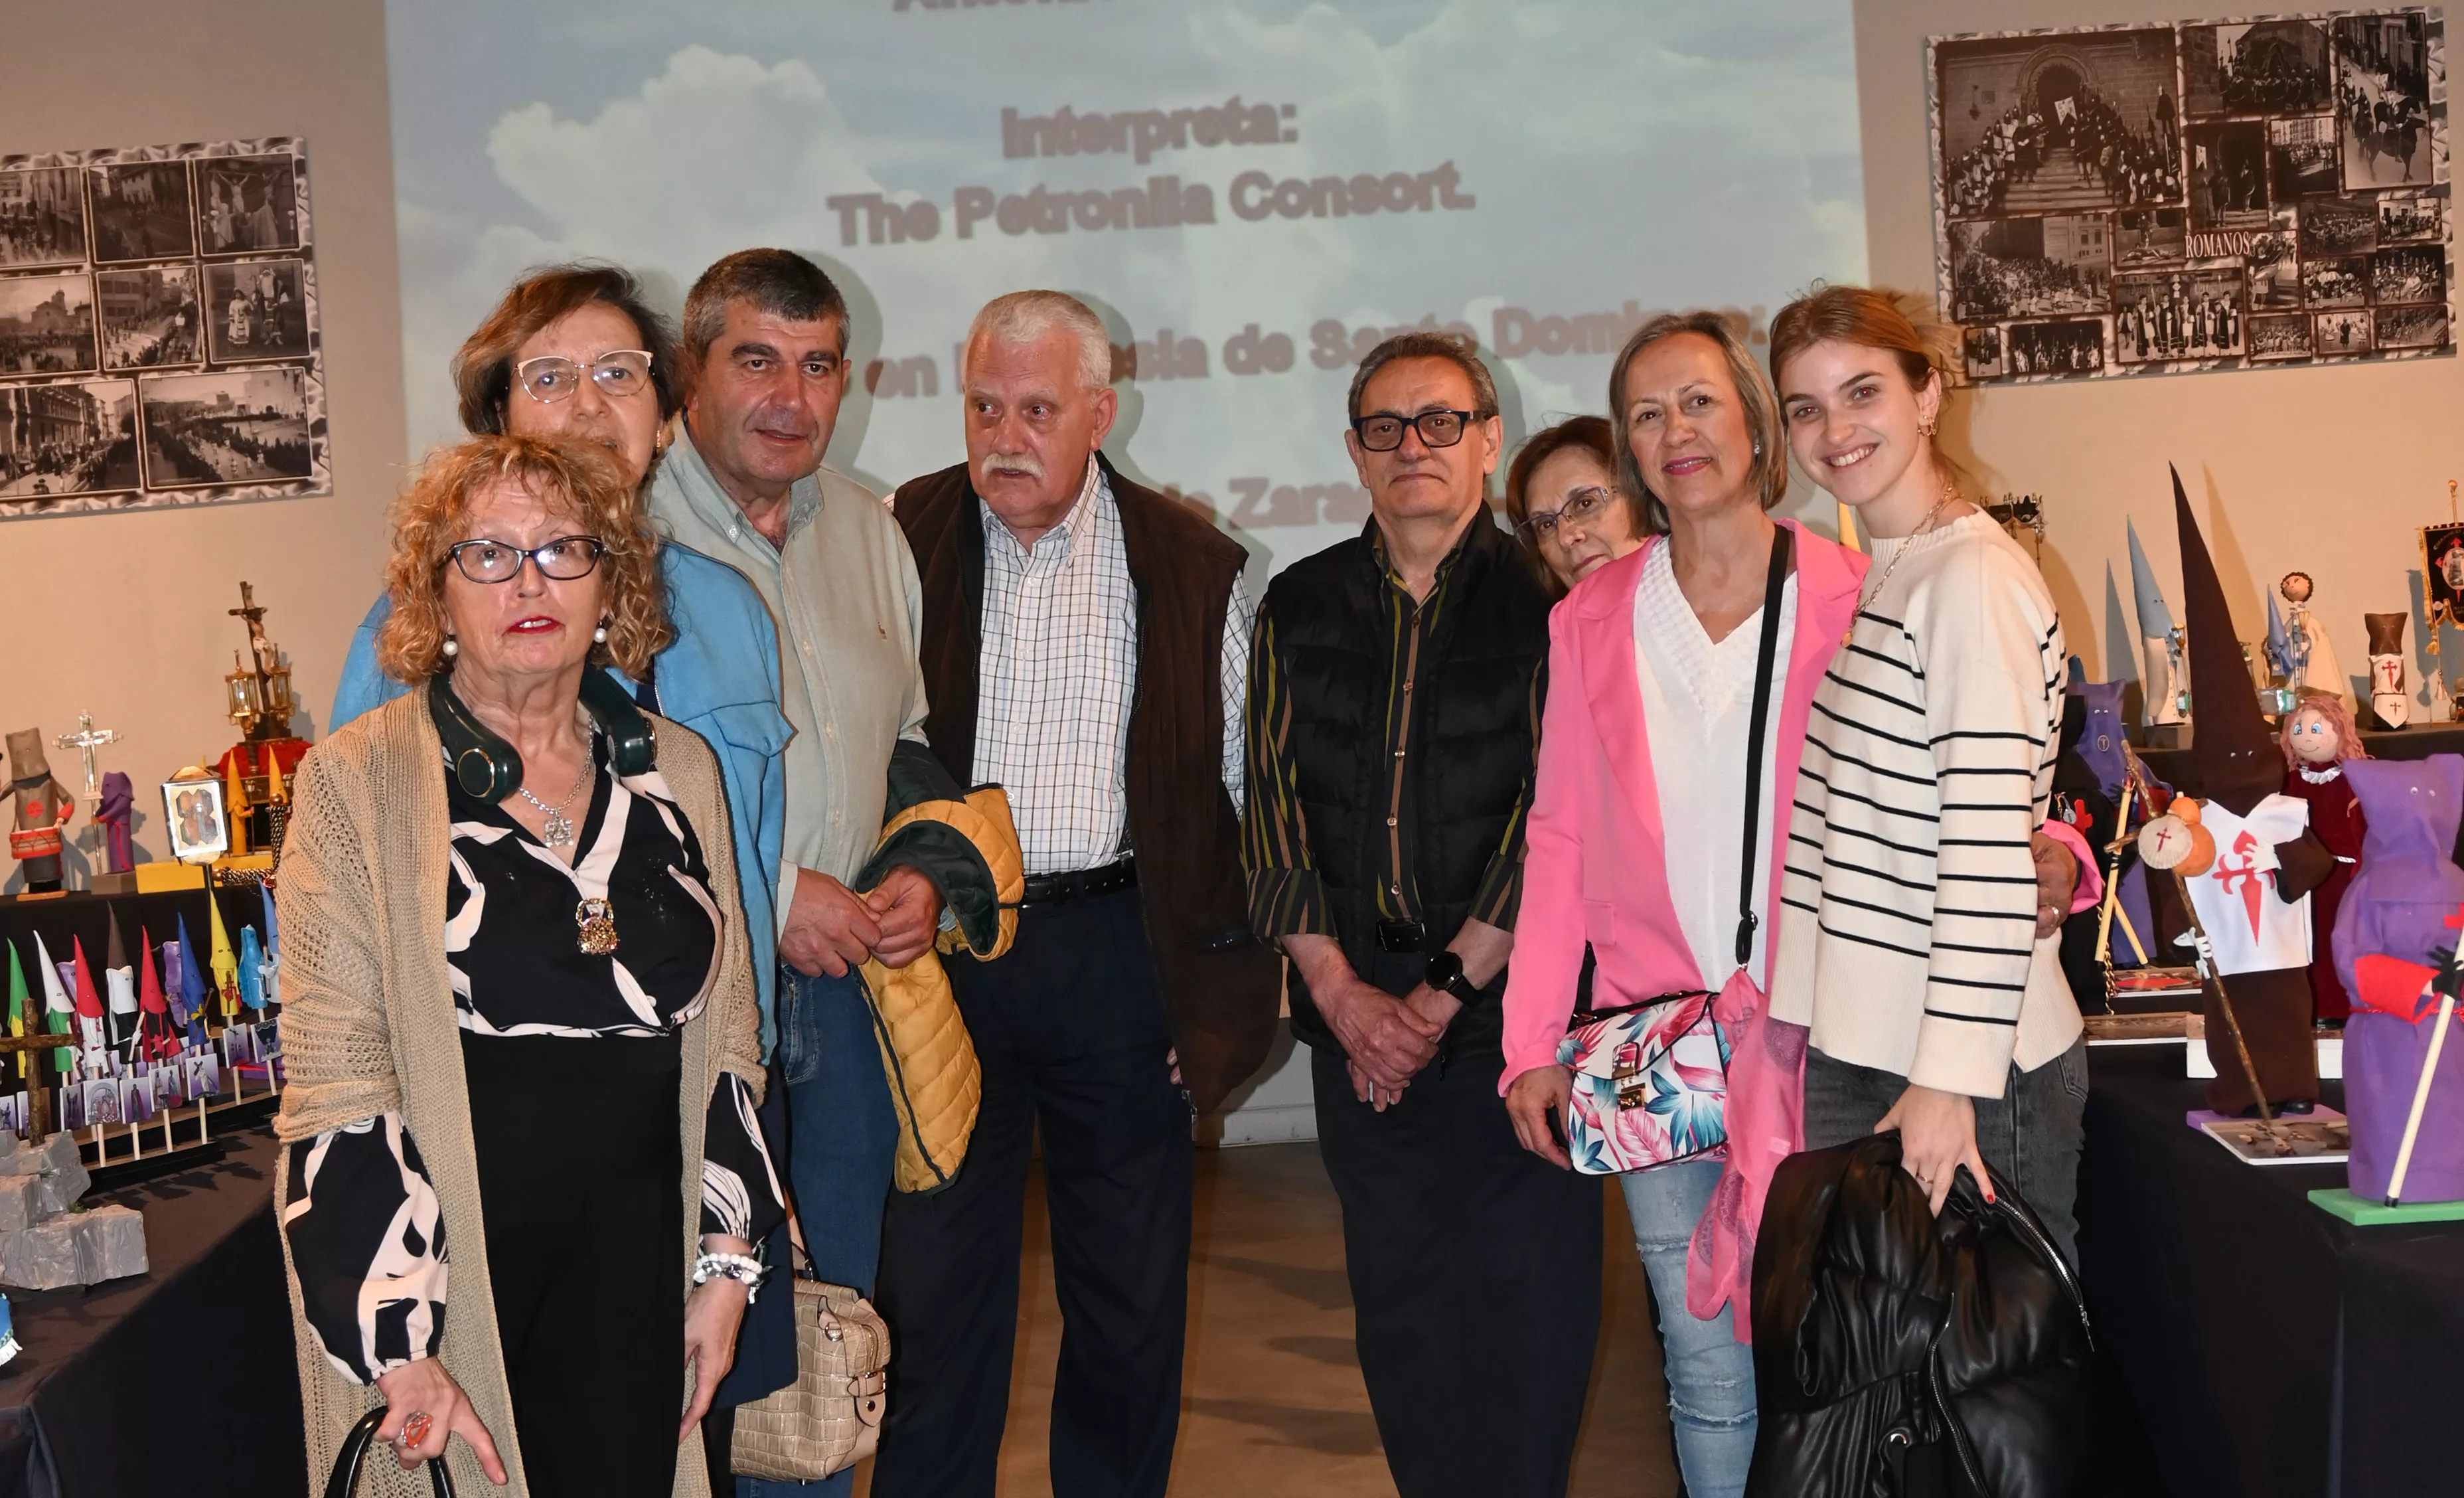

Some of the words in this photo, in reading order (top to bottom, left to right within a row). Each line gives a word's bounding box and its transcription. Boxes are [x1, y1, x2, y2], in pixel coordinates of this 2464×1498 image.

[1001, 94, 1298, 165] Interpreta:
[827, 192, 941, 246] The
[1229, 159, 1476, 221] Consort.
[2185, 230, 2250, 258] ROMANOS
[864, 353, 938, 400] en
[1222, 322, 1296, 376] de
